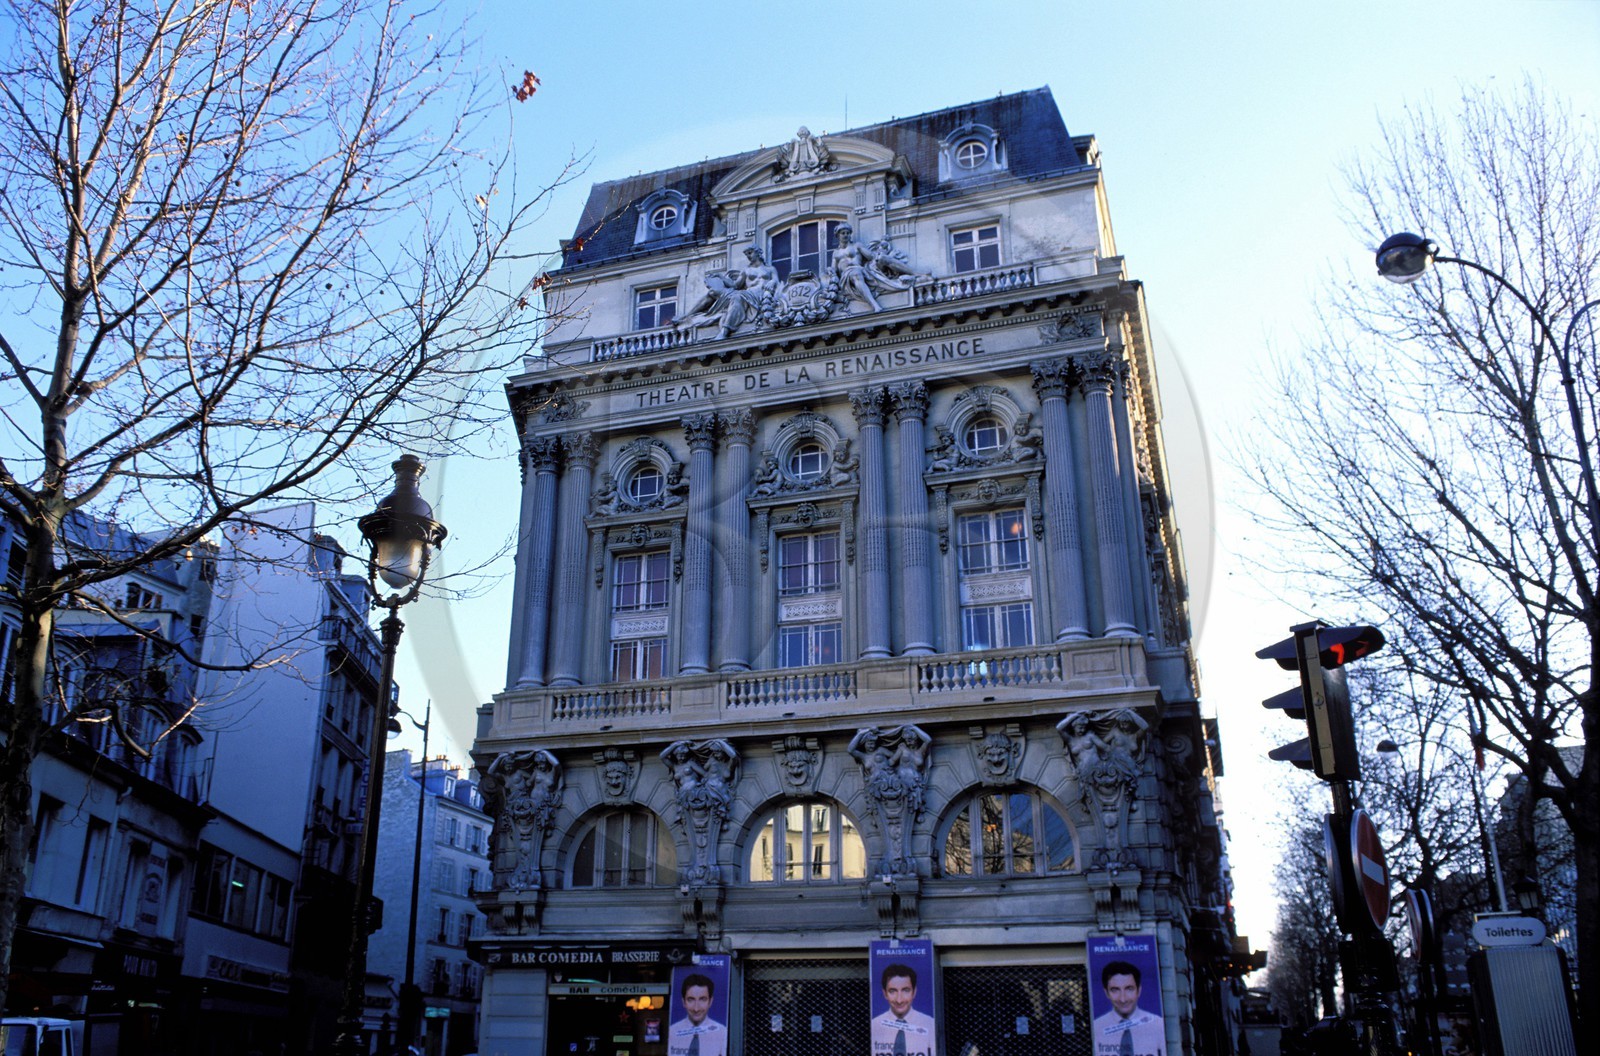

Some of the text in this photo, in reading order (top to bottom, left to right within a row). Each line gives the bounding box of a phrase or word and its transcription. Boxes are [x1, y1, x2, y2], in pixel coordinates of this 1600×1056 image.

[788, 285, 812, 301] 1872
[637, 337, 985, 407] THEATRE DE LA RENAISSANCE
[357, 760, 370, 821] HOTEL
[1484, 926, 1534, 938] Toilettes
[876, 948, 926, 956] RENAISSANCE
[1093, 944, 1150, 953] RENAISSANCE
[512, 952, 536, 963] BAR
[538, 951, 603, 963] COMEDIA
[611, 951, 660, 963] BRASSERIE
